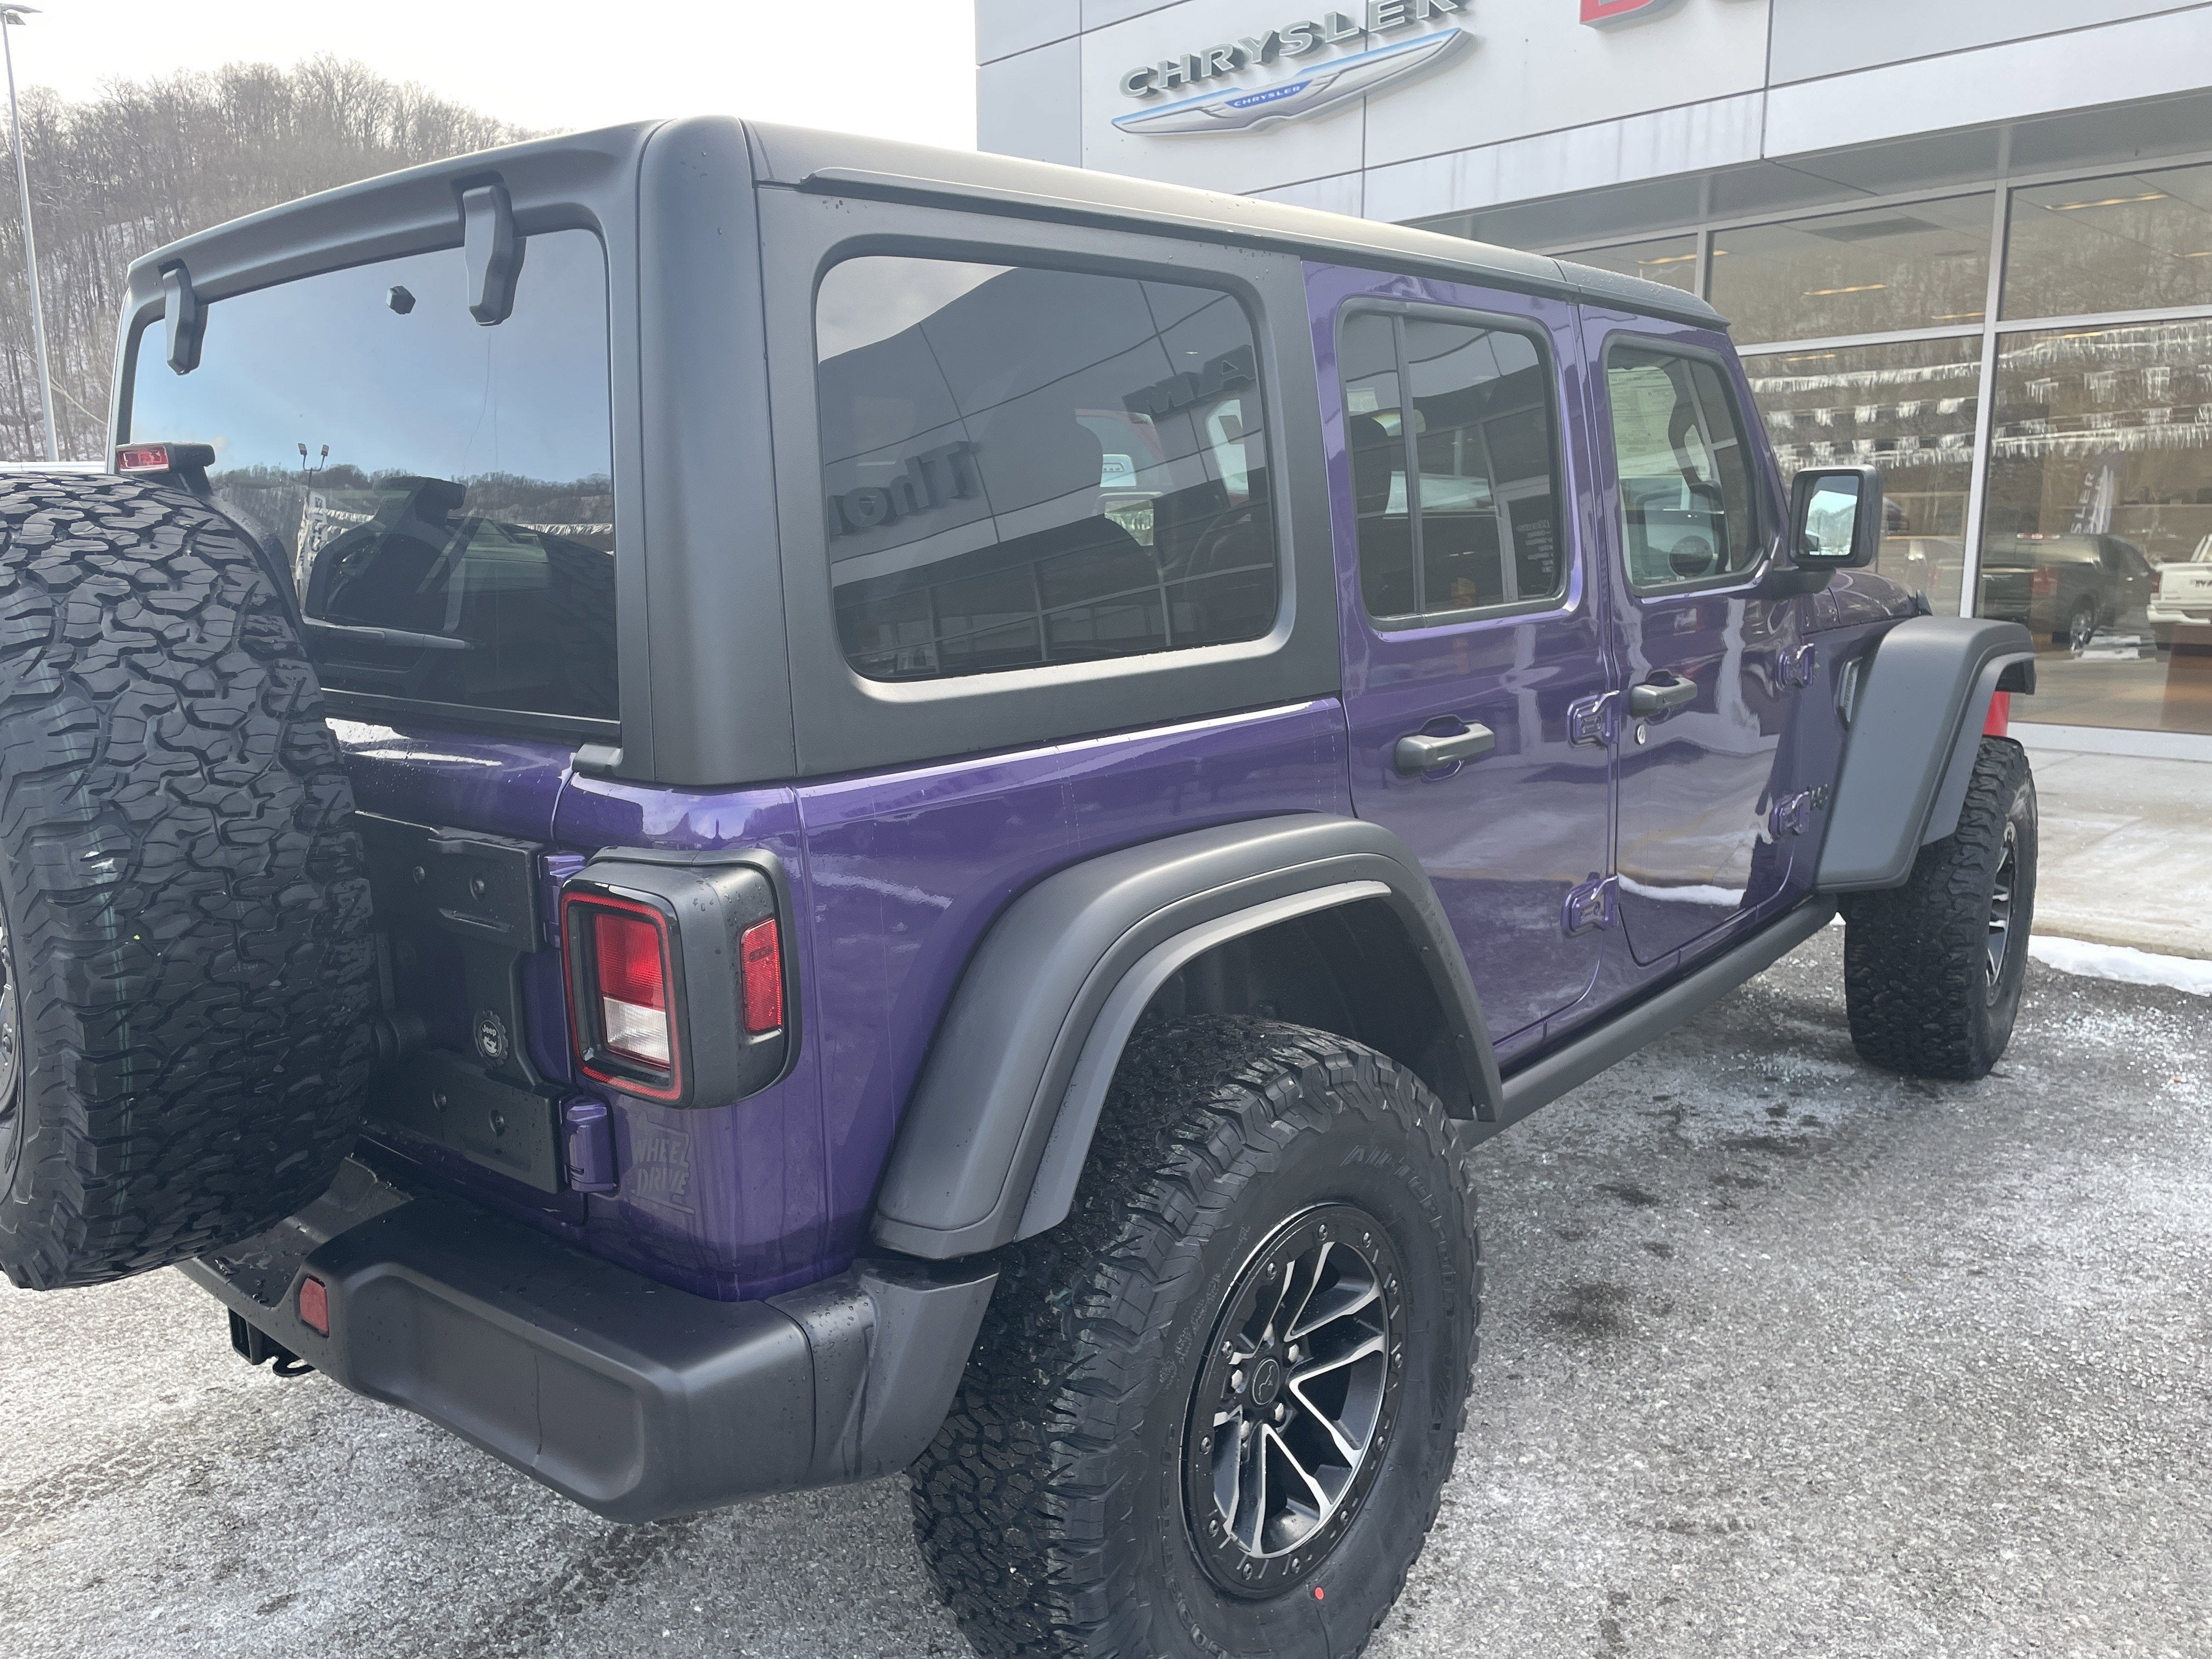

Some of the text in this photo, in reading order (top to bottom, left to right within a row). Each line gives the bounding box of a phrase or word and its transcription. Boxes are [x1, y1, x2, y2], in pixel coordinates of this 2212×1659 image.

[1119, 0, 1459, 98] CHRYSLER
[1234, 86, 1301, 107] CHRYSLER
[482, 1024, 497, 1037] Jeep
[633, 1137, 690, 1167] WHEEL
[636, 1166, 690, 1197] DRIVE
